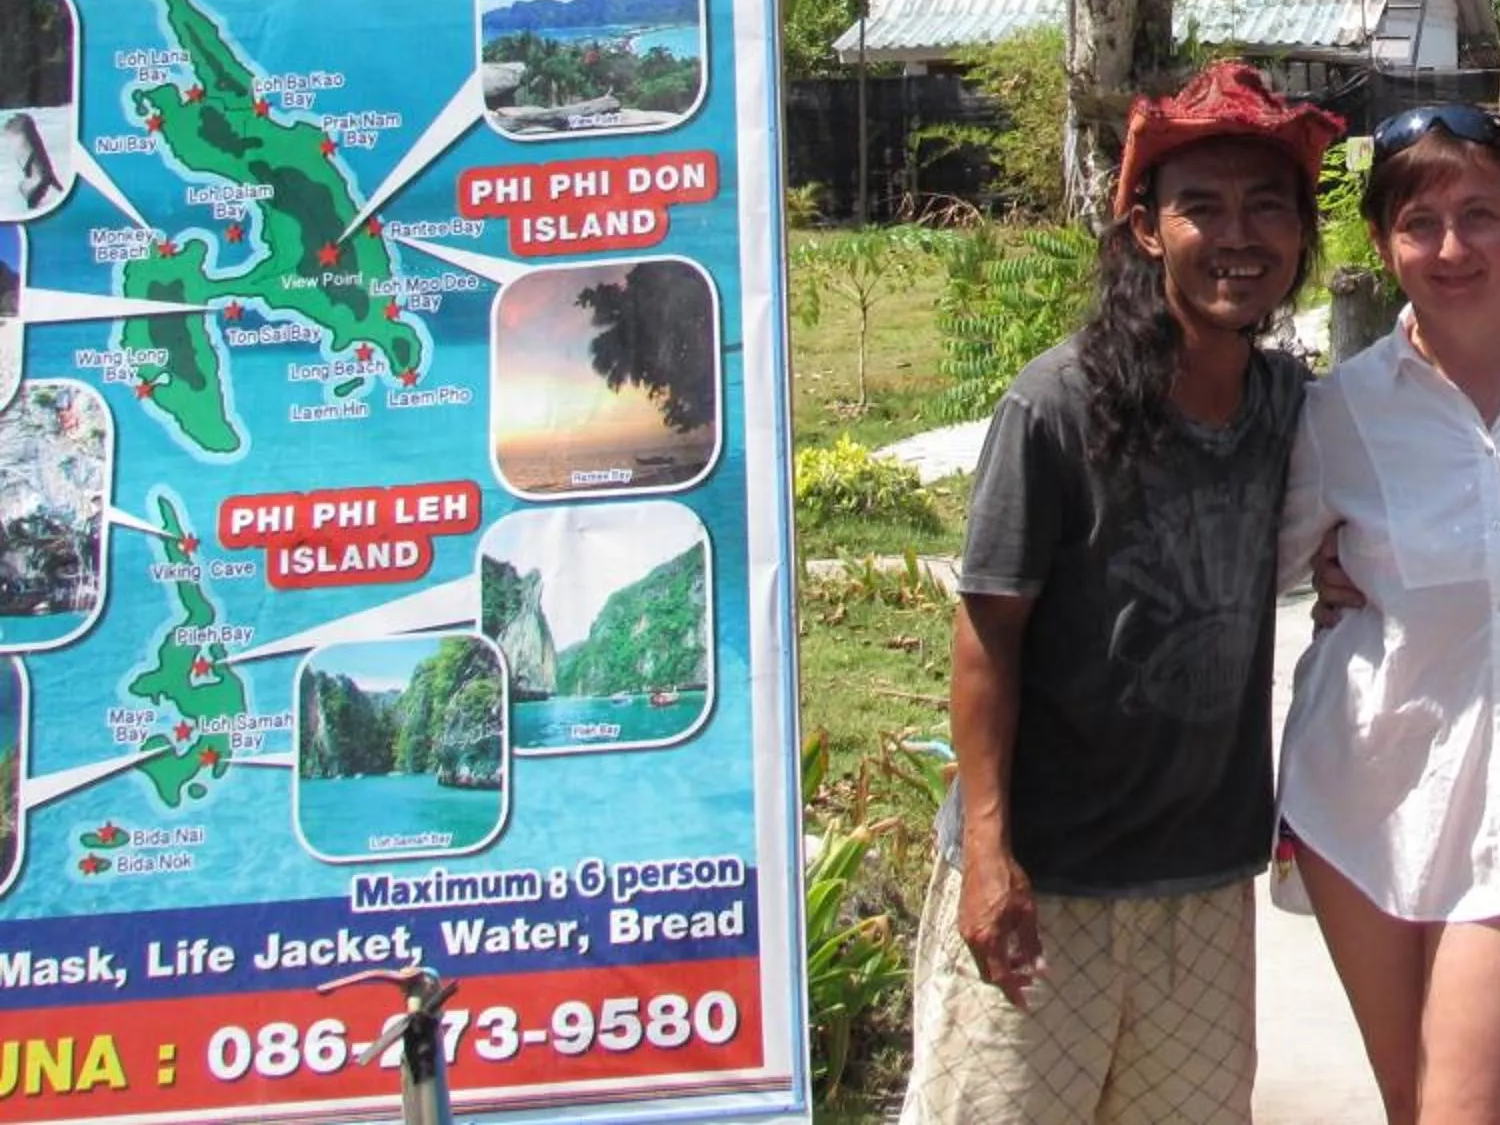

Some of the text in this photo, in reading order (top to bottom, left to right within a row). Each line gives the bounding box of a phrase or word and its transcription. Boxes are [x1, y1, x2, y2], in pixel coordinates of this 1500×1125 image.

[151, 50, 190, 65] Lana
[138, 67, 168, 82] Bay
[255, 78, 282, 92] Loh
[283, 91, 313, 107] Bay
[363, 114, 398, 127] Nam
[127, 136, 157, 152] Bay
[346, 131, 377, 145] Bay
[471, 162, 706, 205] PHI PHI DON
[215, 203, 246, 219] Bay
[390, 218, 484, 236] Rantee Bay
[522, 210, 657, 243] ISLAND
[93, 229, 152, 244] Monkey
[97, 246, 149, 260] Beach
[281, 272, 363, 288] View Point
[445, 274, 478, 289] Dee
[410, 295, 441, 311] Bay
[229, 329, 257, 343] Ton
[291, 325, 321, 343] Bay
[78, 347, 167, 366] Wang Long
[105, 368, 137, 382] Bay
[291, 361, 385, 380] Long Beach
[390, 391, 434, 406] Laem
[292, 402, 368, 420] Laem Hin
[231, 494, 468, 534] PHI PHI LEH
[279, 541, 420, 576] ISLAND
[153, 561, 255, 581] Viking Cave
[221, 626, 254, 643] Bay
[109, 709, 155, 726] Maya
[201, 714, 293, 733] Loh Samah
[115, 727, 148, 743] Bay
[231, 732, 263, 748] Bay
[133, 827, 204, 846] Bida Nai
[117, 854, 192, 873] Bida Nok
[355, 872, 537, 909] Maximum
[577, 863, 602, 894] 6
[616, 858, 740, 900] person
[0, 902, 743, 988] Mask, Life Jacket, Water, Bread
